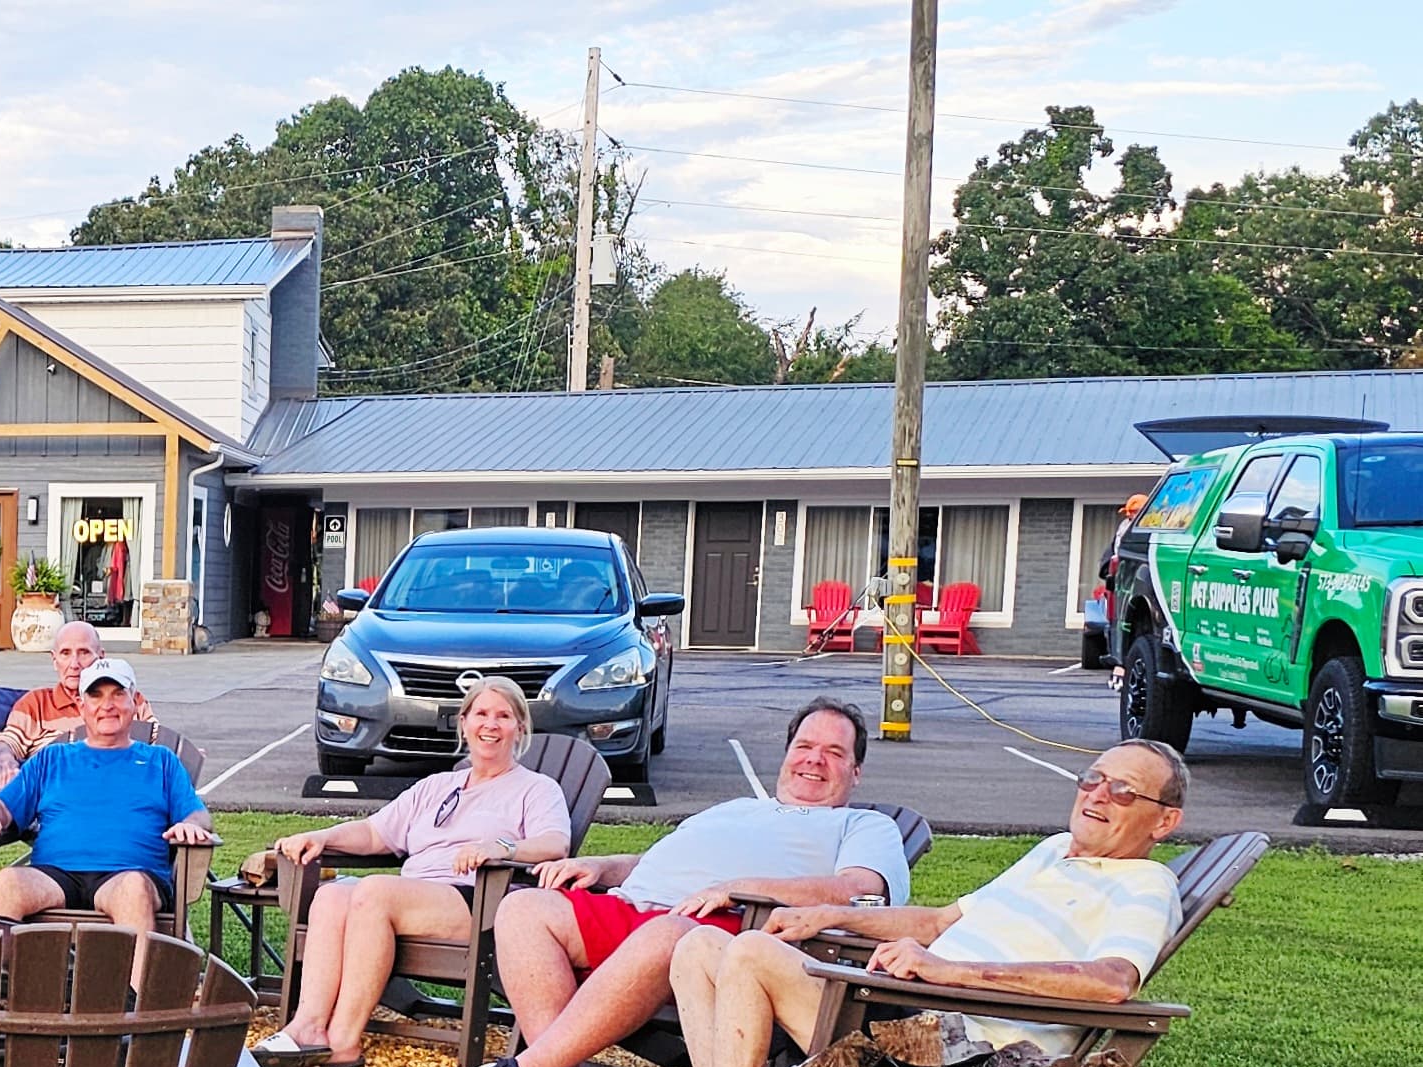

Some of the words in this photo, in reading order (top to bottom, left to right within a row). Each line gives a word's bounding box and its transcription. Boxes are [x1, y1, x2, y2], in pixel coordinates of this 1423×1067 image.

[73, 519, 133, 543] OPEN
[326, 535, 342, 544] POOL
[1191, 580, 1207, 609] PET
[1208, 582, 1251, 614] SUPPLIES
[1252, 586, 1280, 618] PLUS
